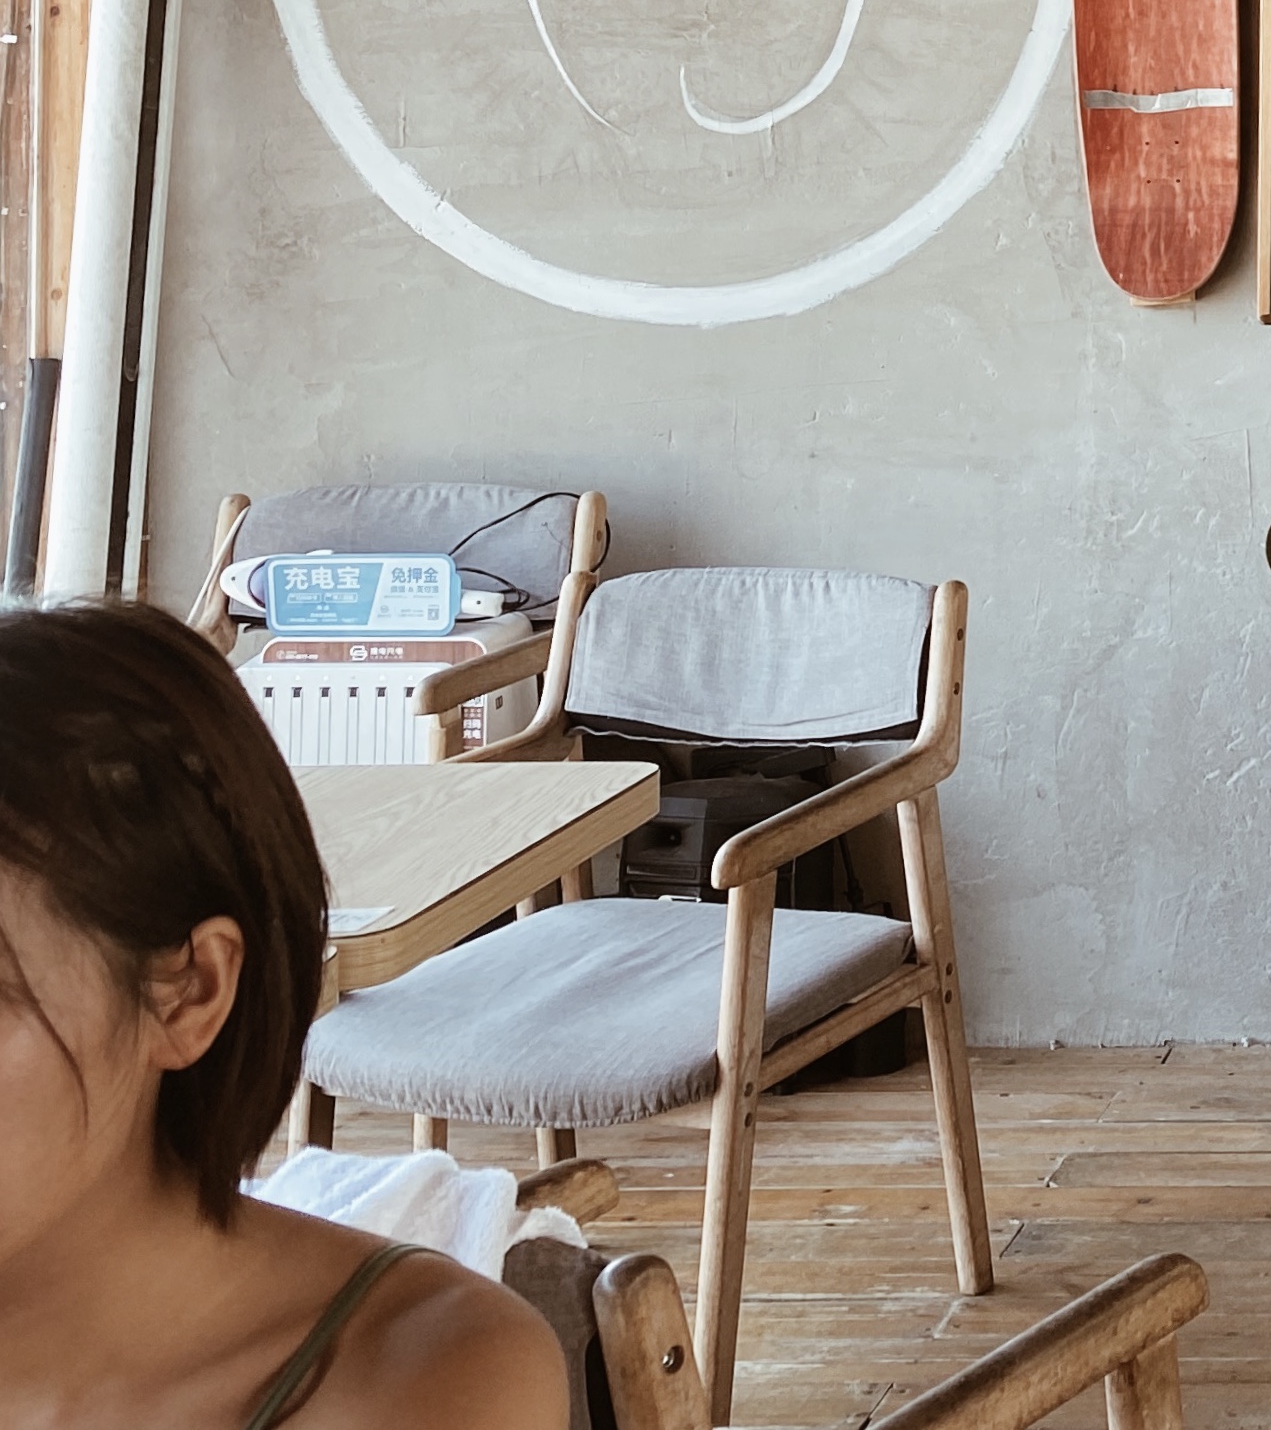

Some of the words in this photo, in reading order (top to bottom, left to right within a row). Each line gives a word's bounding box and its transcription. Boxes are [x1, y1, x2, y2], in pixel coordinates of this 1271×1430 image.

[283, 566, 361, 591] 充电宝
[391, 567, 439, 583] 免押金
